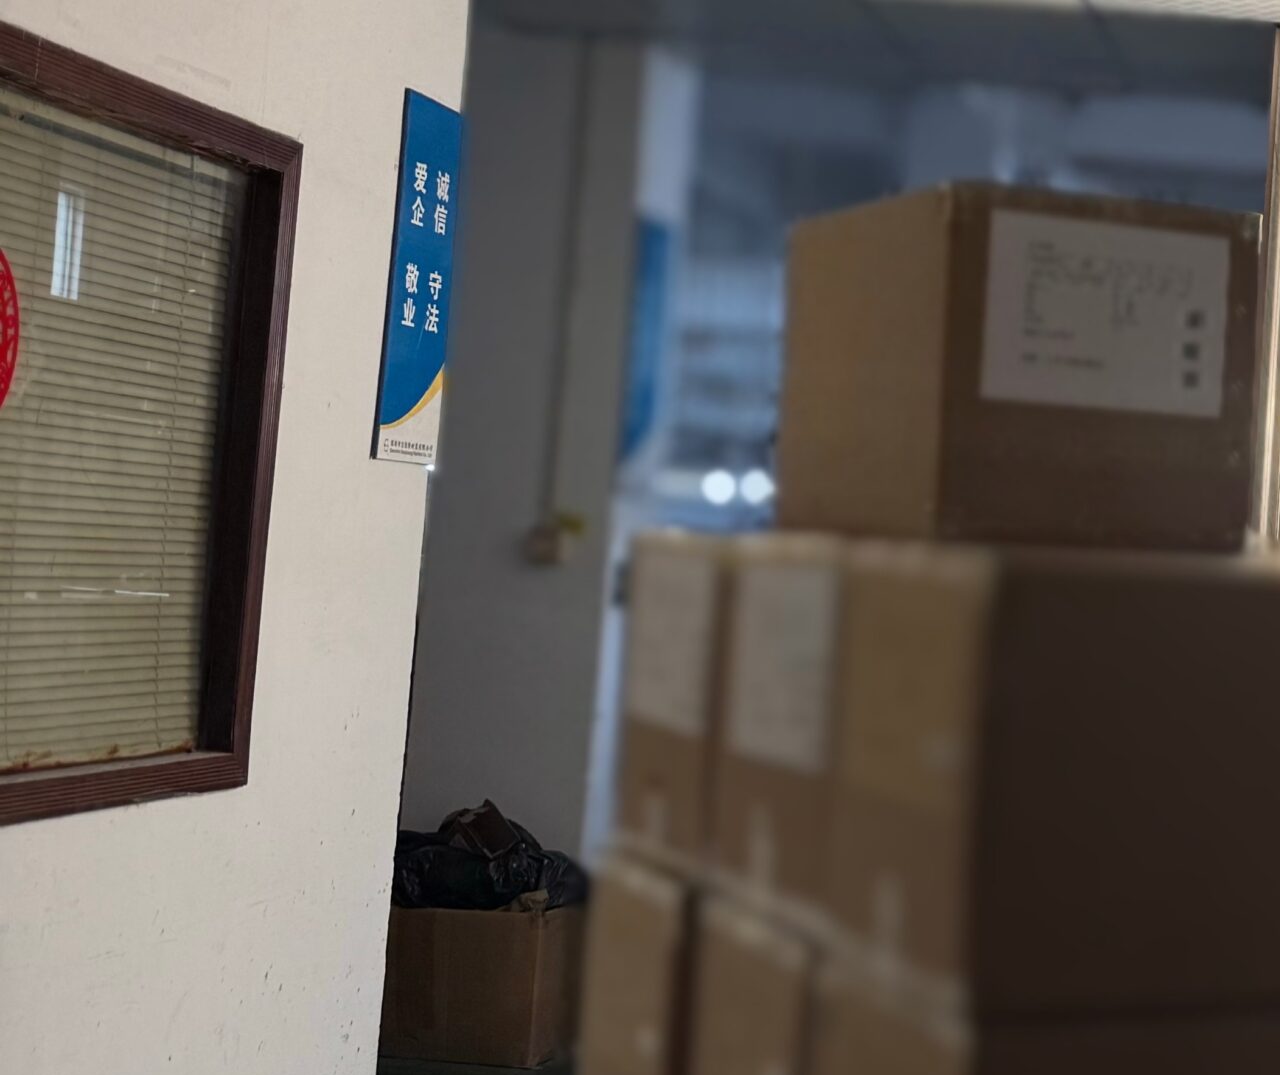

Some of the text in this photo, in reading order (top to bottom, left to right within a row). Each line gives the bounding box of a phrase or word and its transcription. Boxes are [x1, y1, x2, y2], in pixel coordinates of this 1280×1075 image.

[401, 161, 428, 328] 爱企 敬业
[424, 170, 451, 334] 诚信 守法
